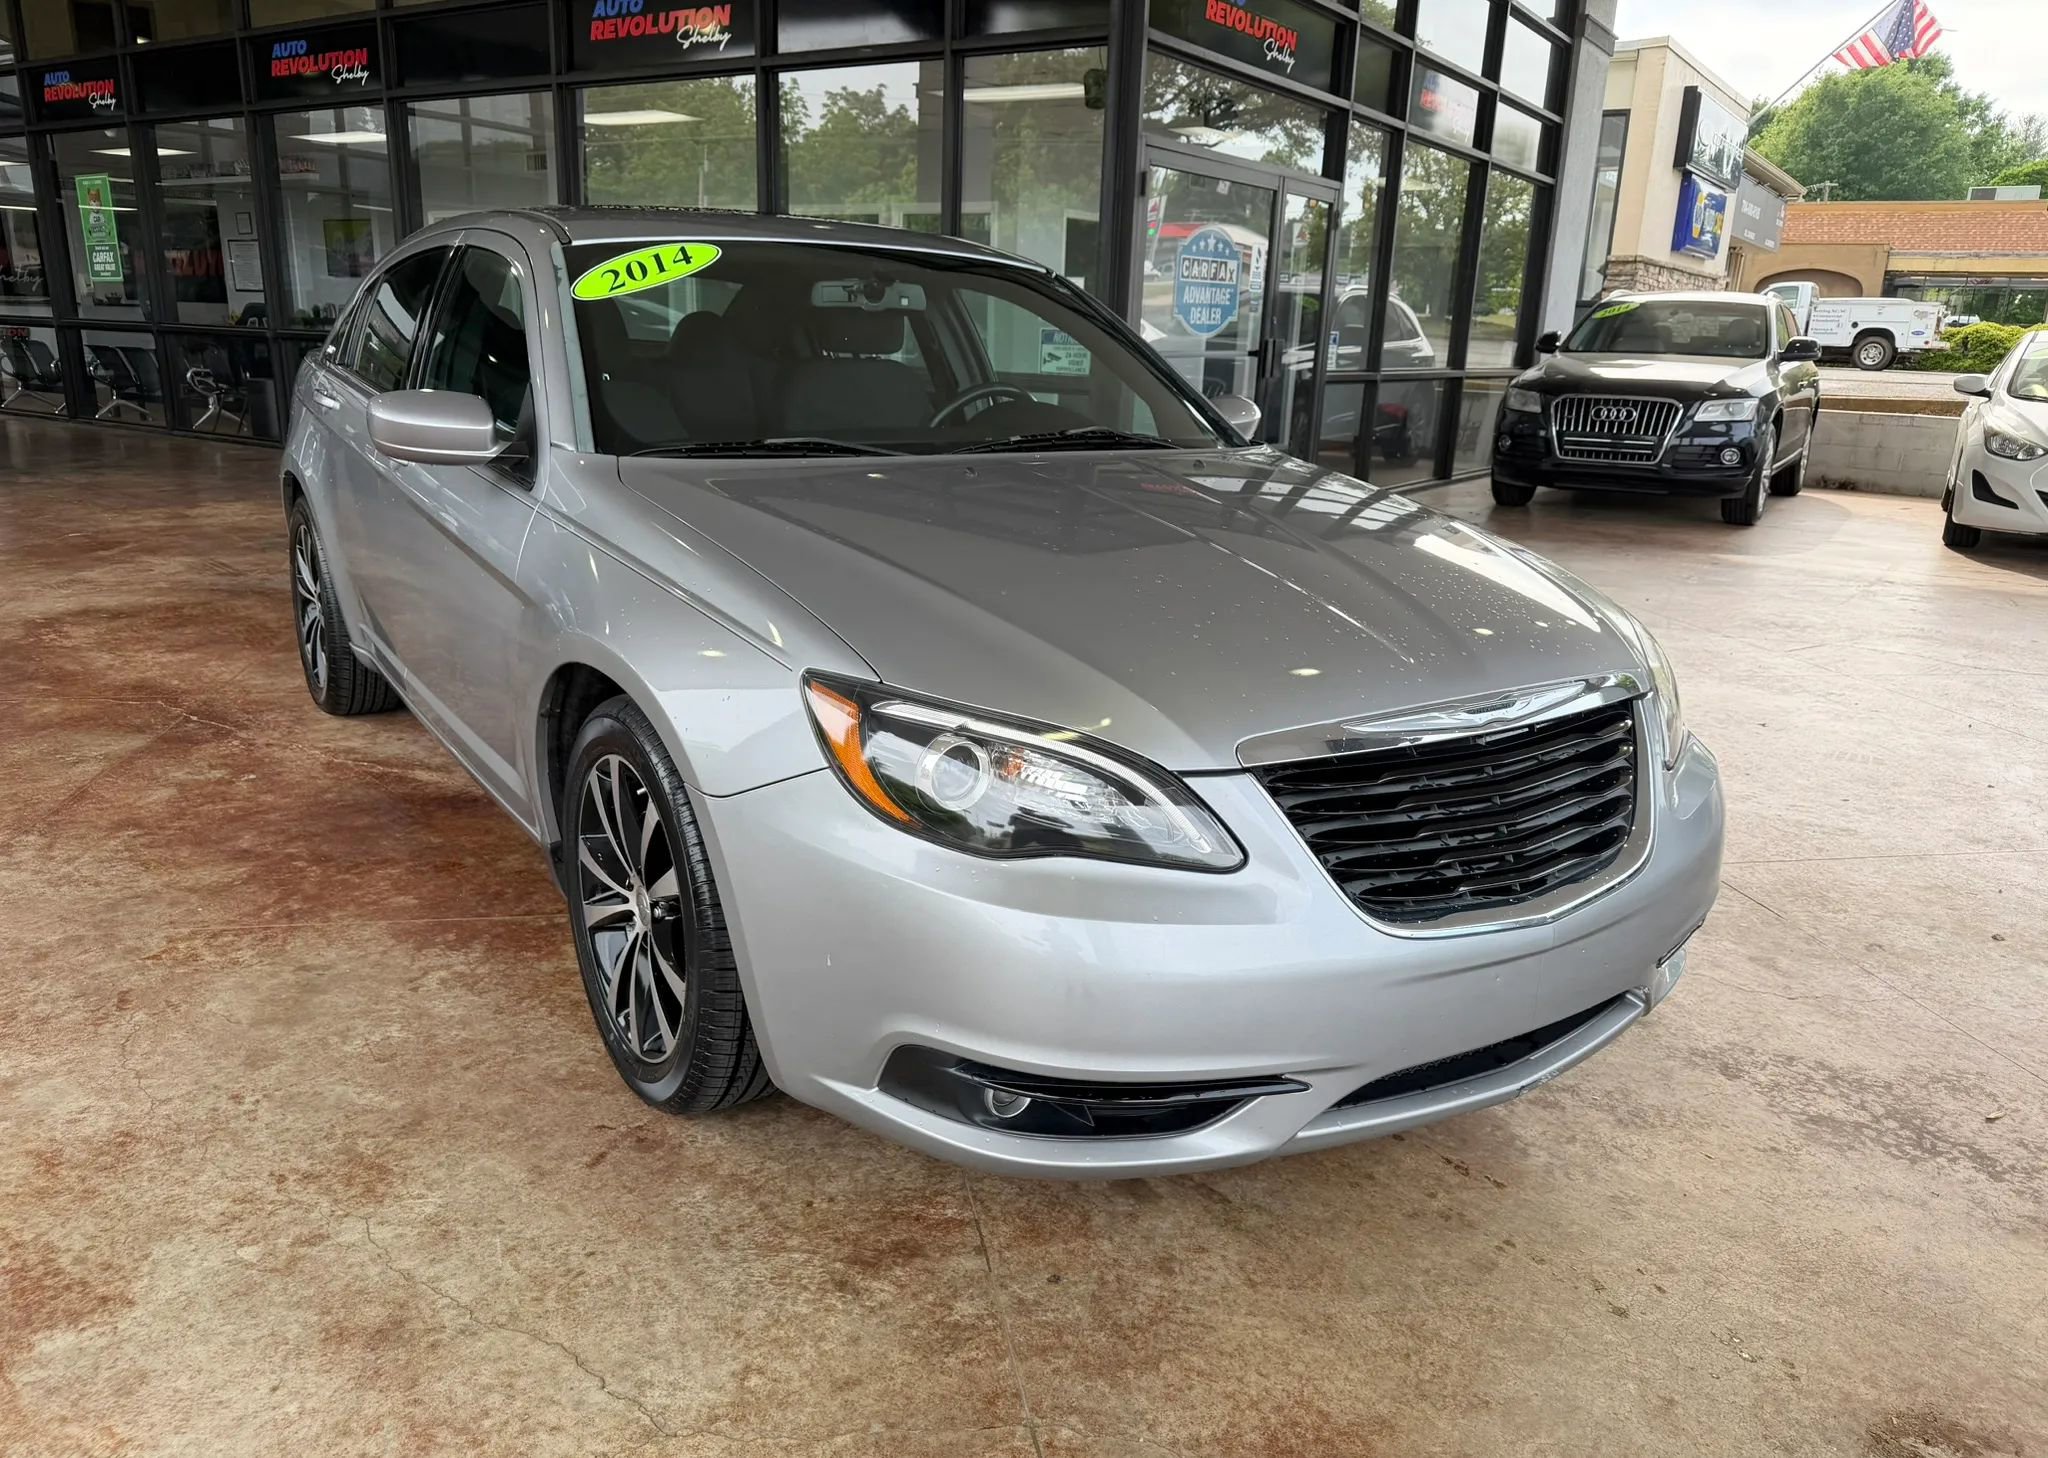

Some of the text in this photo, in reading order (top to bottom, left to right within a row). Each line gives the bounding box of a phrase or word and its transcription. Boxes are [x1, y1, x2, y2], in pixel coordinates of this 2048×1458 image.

[592, 0, 643, 18] AUTO
[590, 4, 732, 40] REVOLUTION
[1205, 0, 1298, 51] REVOLUTION
[676, 21, 732, 50] Shelby
[271, 40, 307, 58] AUTO
[1264, 37, 1296, 73] Shelby
[271, 48, 368, 77] REVOLUTION
[331, 60, 369, 86] Shelby
[44, 70, 70, 86] AUTO
[44, 79, 115, 103] REVOLUTION
[88, 89, 117, 111] Shelby
[92, 251, 115, 263] CARFAX
[601, 246, 693, 292] 2014
[1182, 257, 1235, 282] CARFAX
[1183, 286, 1231, 304] ADVANTAGE
[1190, 307, 1222, 324] DEALER
